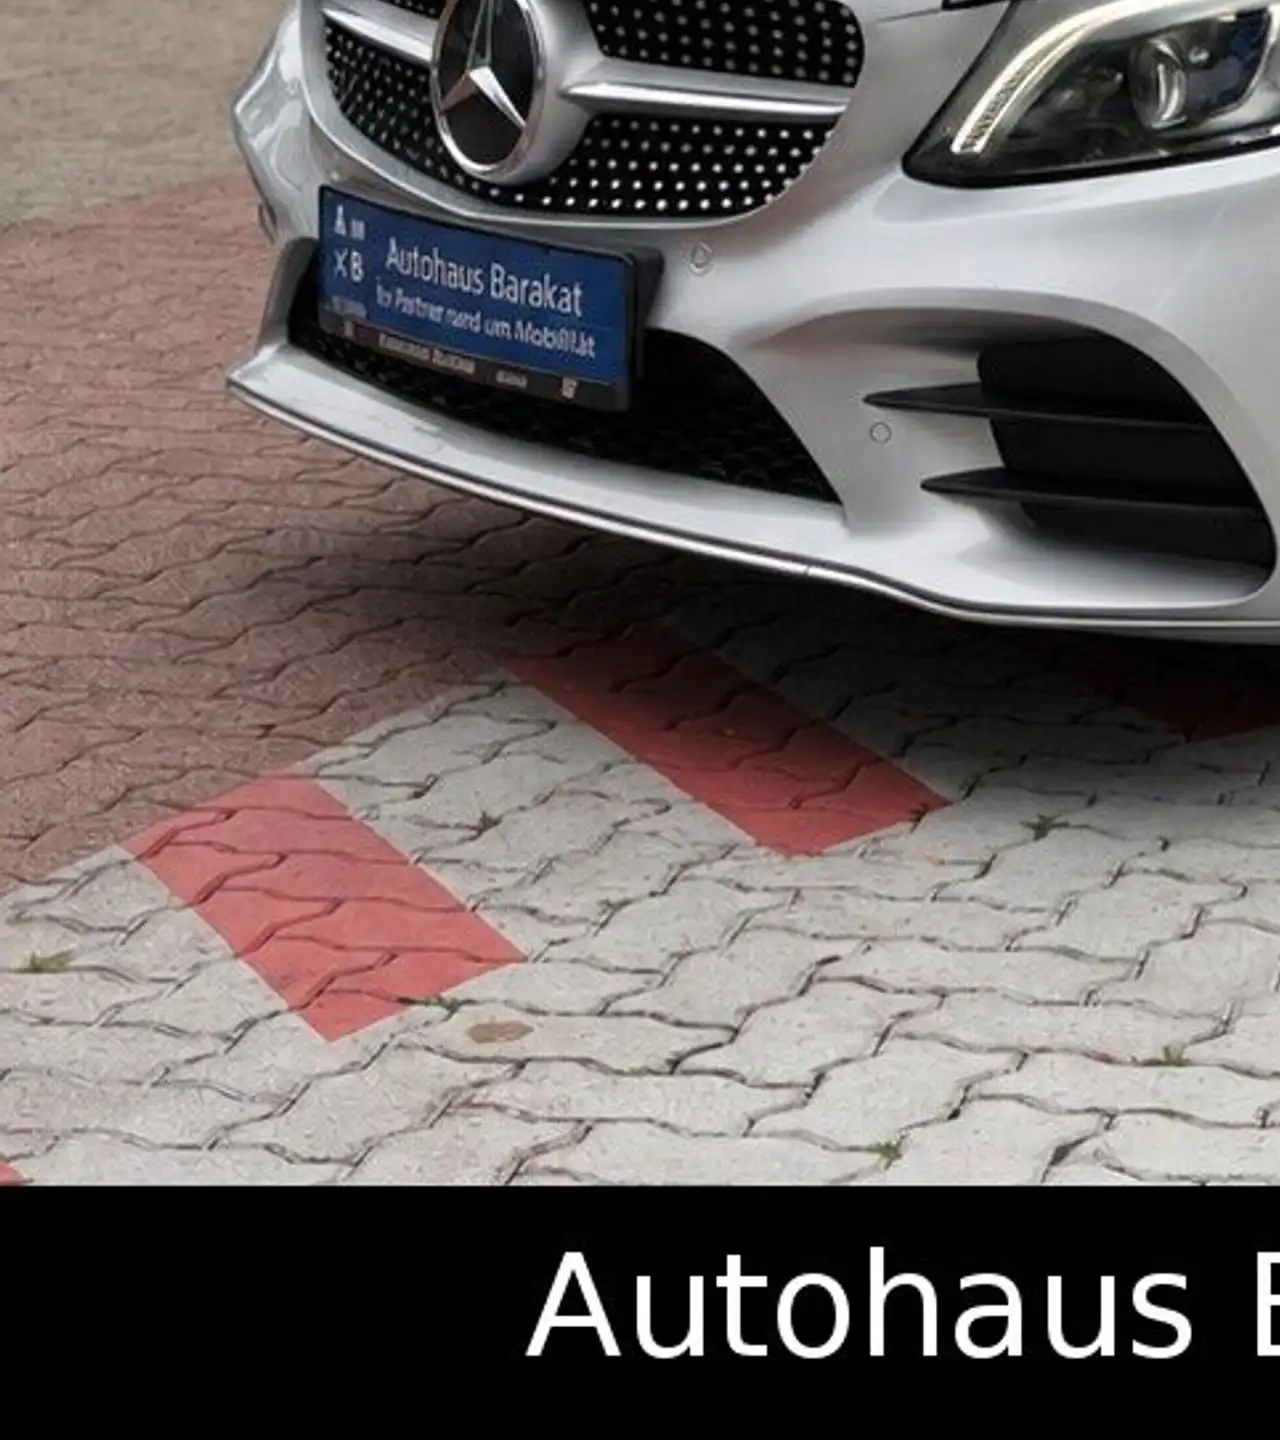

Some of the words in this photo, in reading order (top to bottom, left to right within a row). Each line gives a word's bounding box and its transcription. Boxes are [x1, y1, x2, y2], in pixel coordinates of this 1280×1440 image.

[384, 236, 484, 296] Autohaus
[490, 262, 582, 318] Barakat
[484, 317, 513, 341] um
